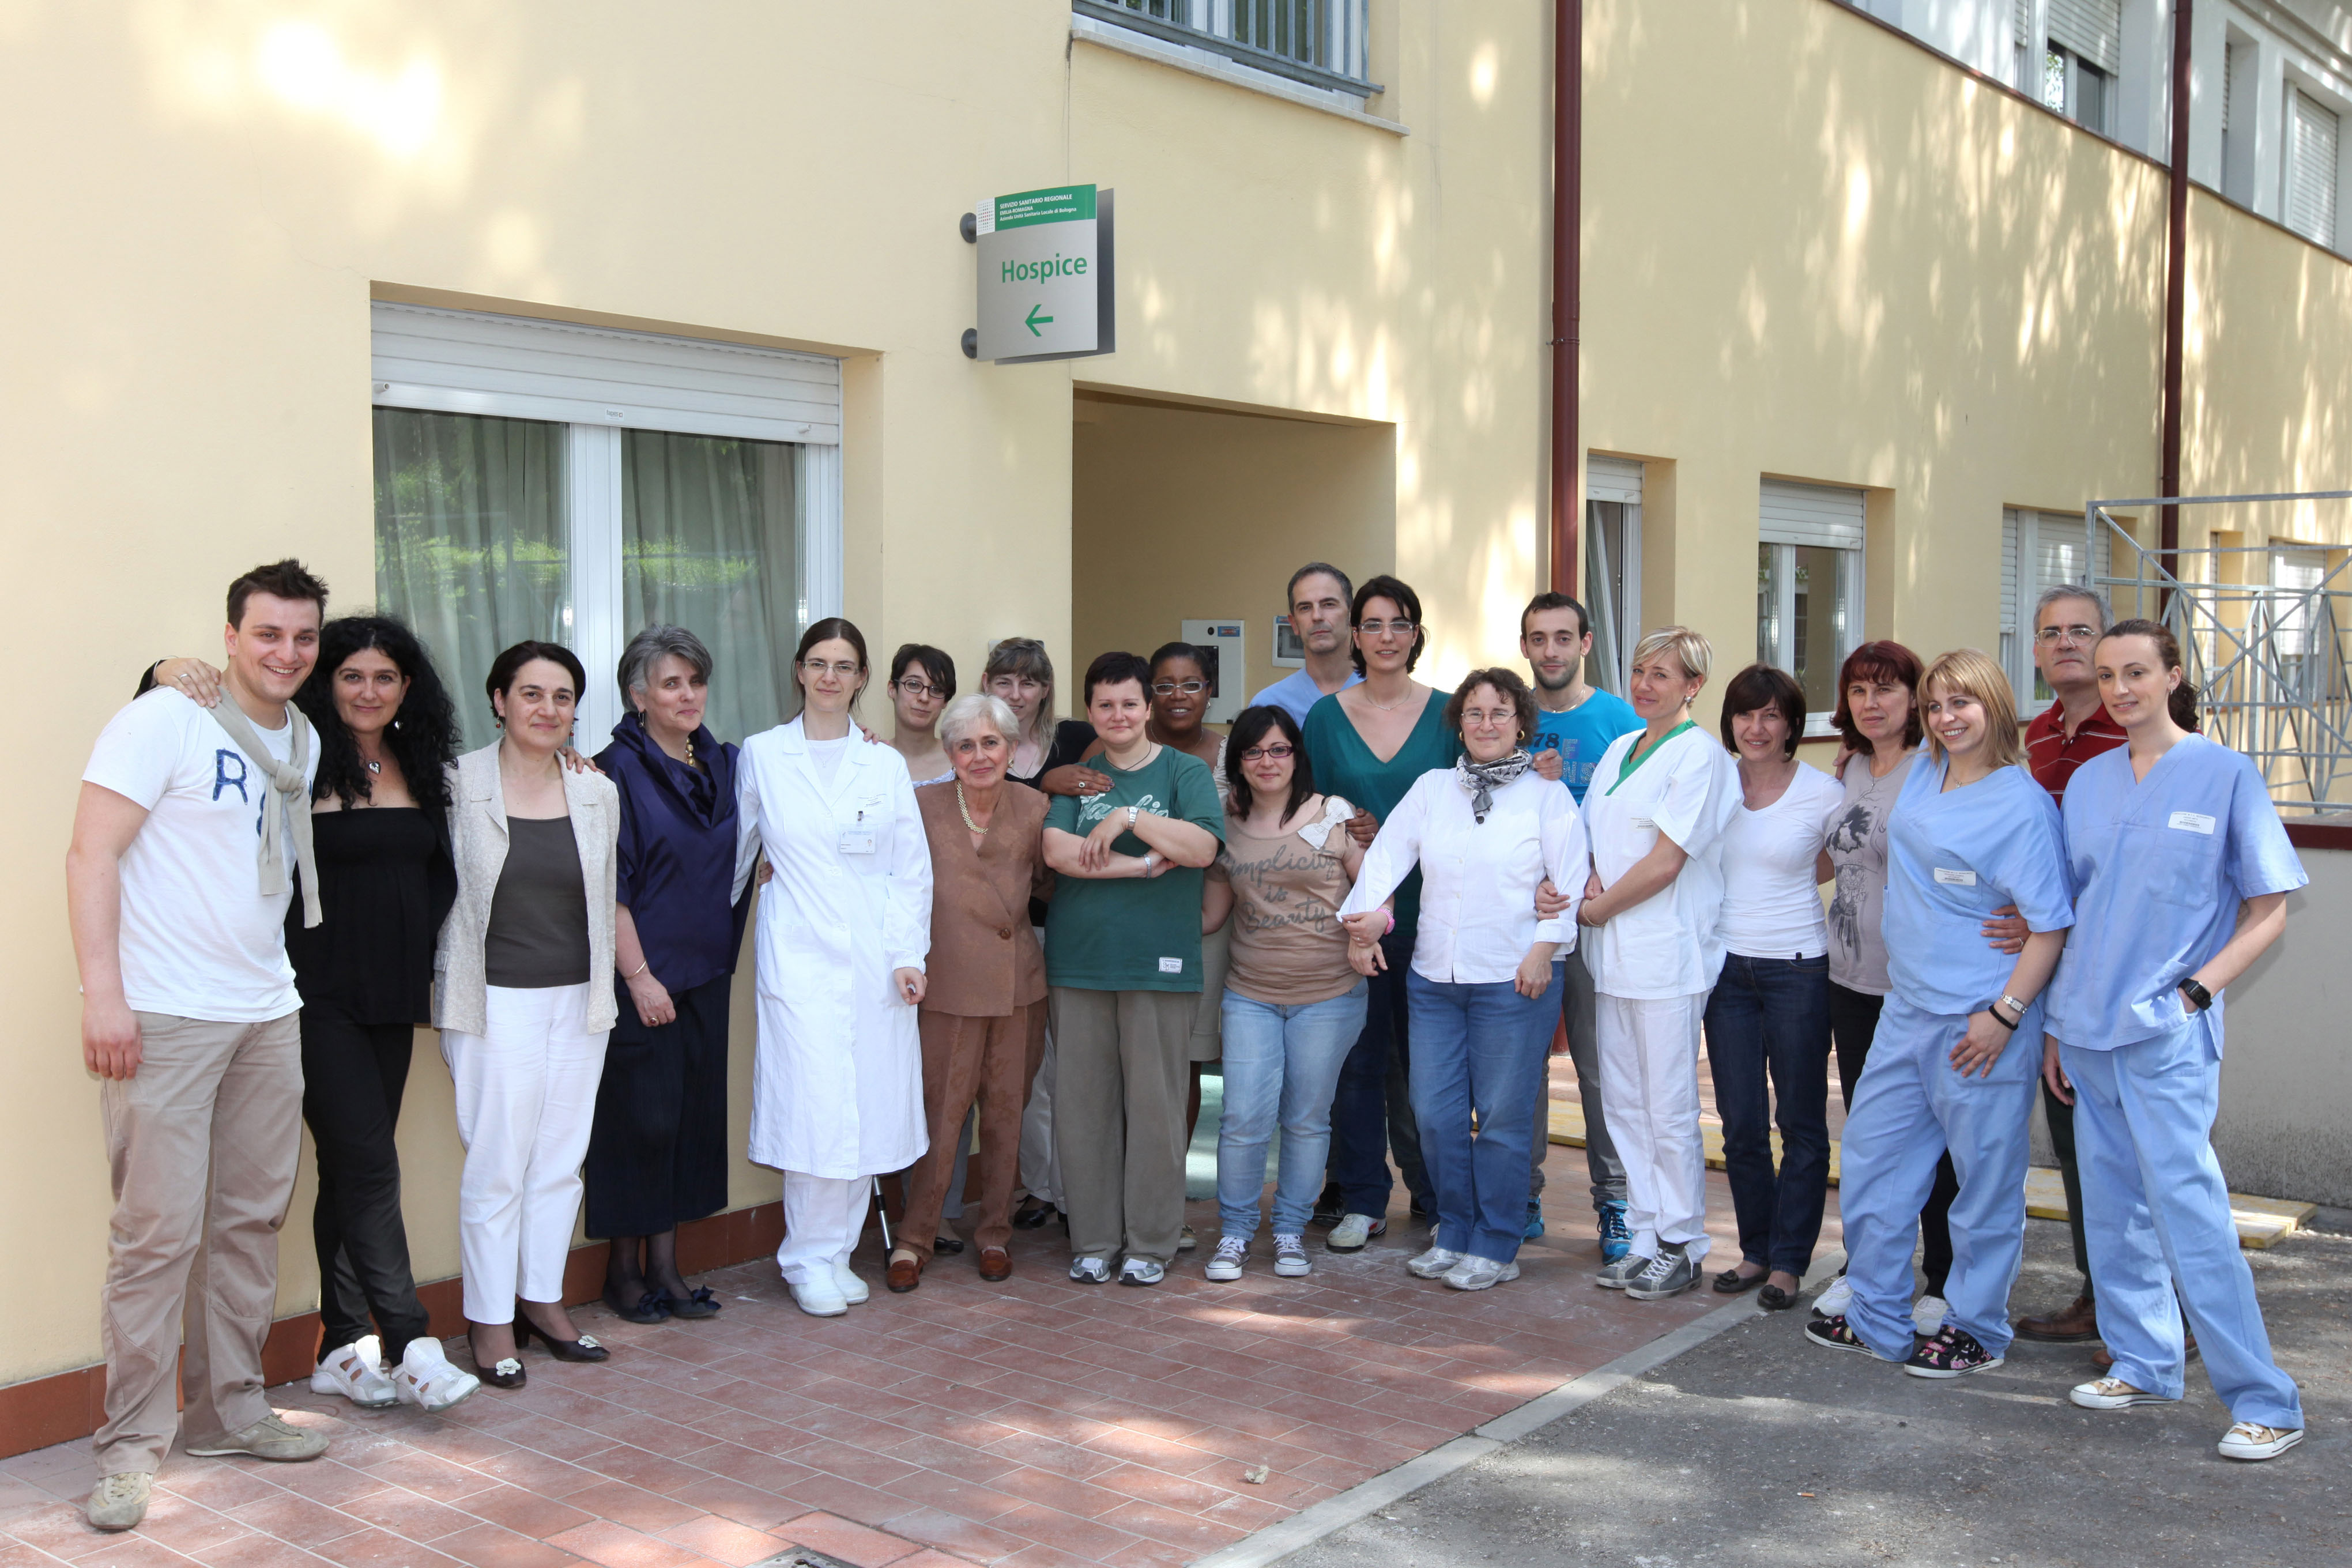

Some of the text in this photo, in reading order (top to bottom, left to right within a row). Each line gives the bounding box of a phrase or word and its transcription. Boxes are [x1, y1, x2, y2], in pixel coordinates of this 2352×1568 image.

[1019, 197, 1043, 206] SANITARIO
[1044, 194, 1072, 202] REGIONALE
[1000, 206, 1033, 216] EMILIA-ROMAGNA
[1001, 252, 1088, 284] Hospice
[1264, 885, 1288, 903] is
[1243, 896, 1330, 934] Beauty
